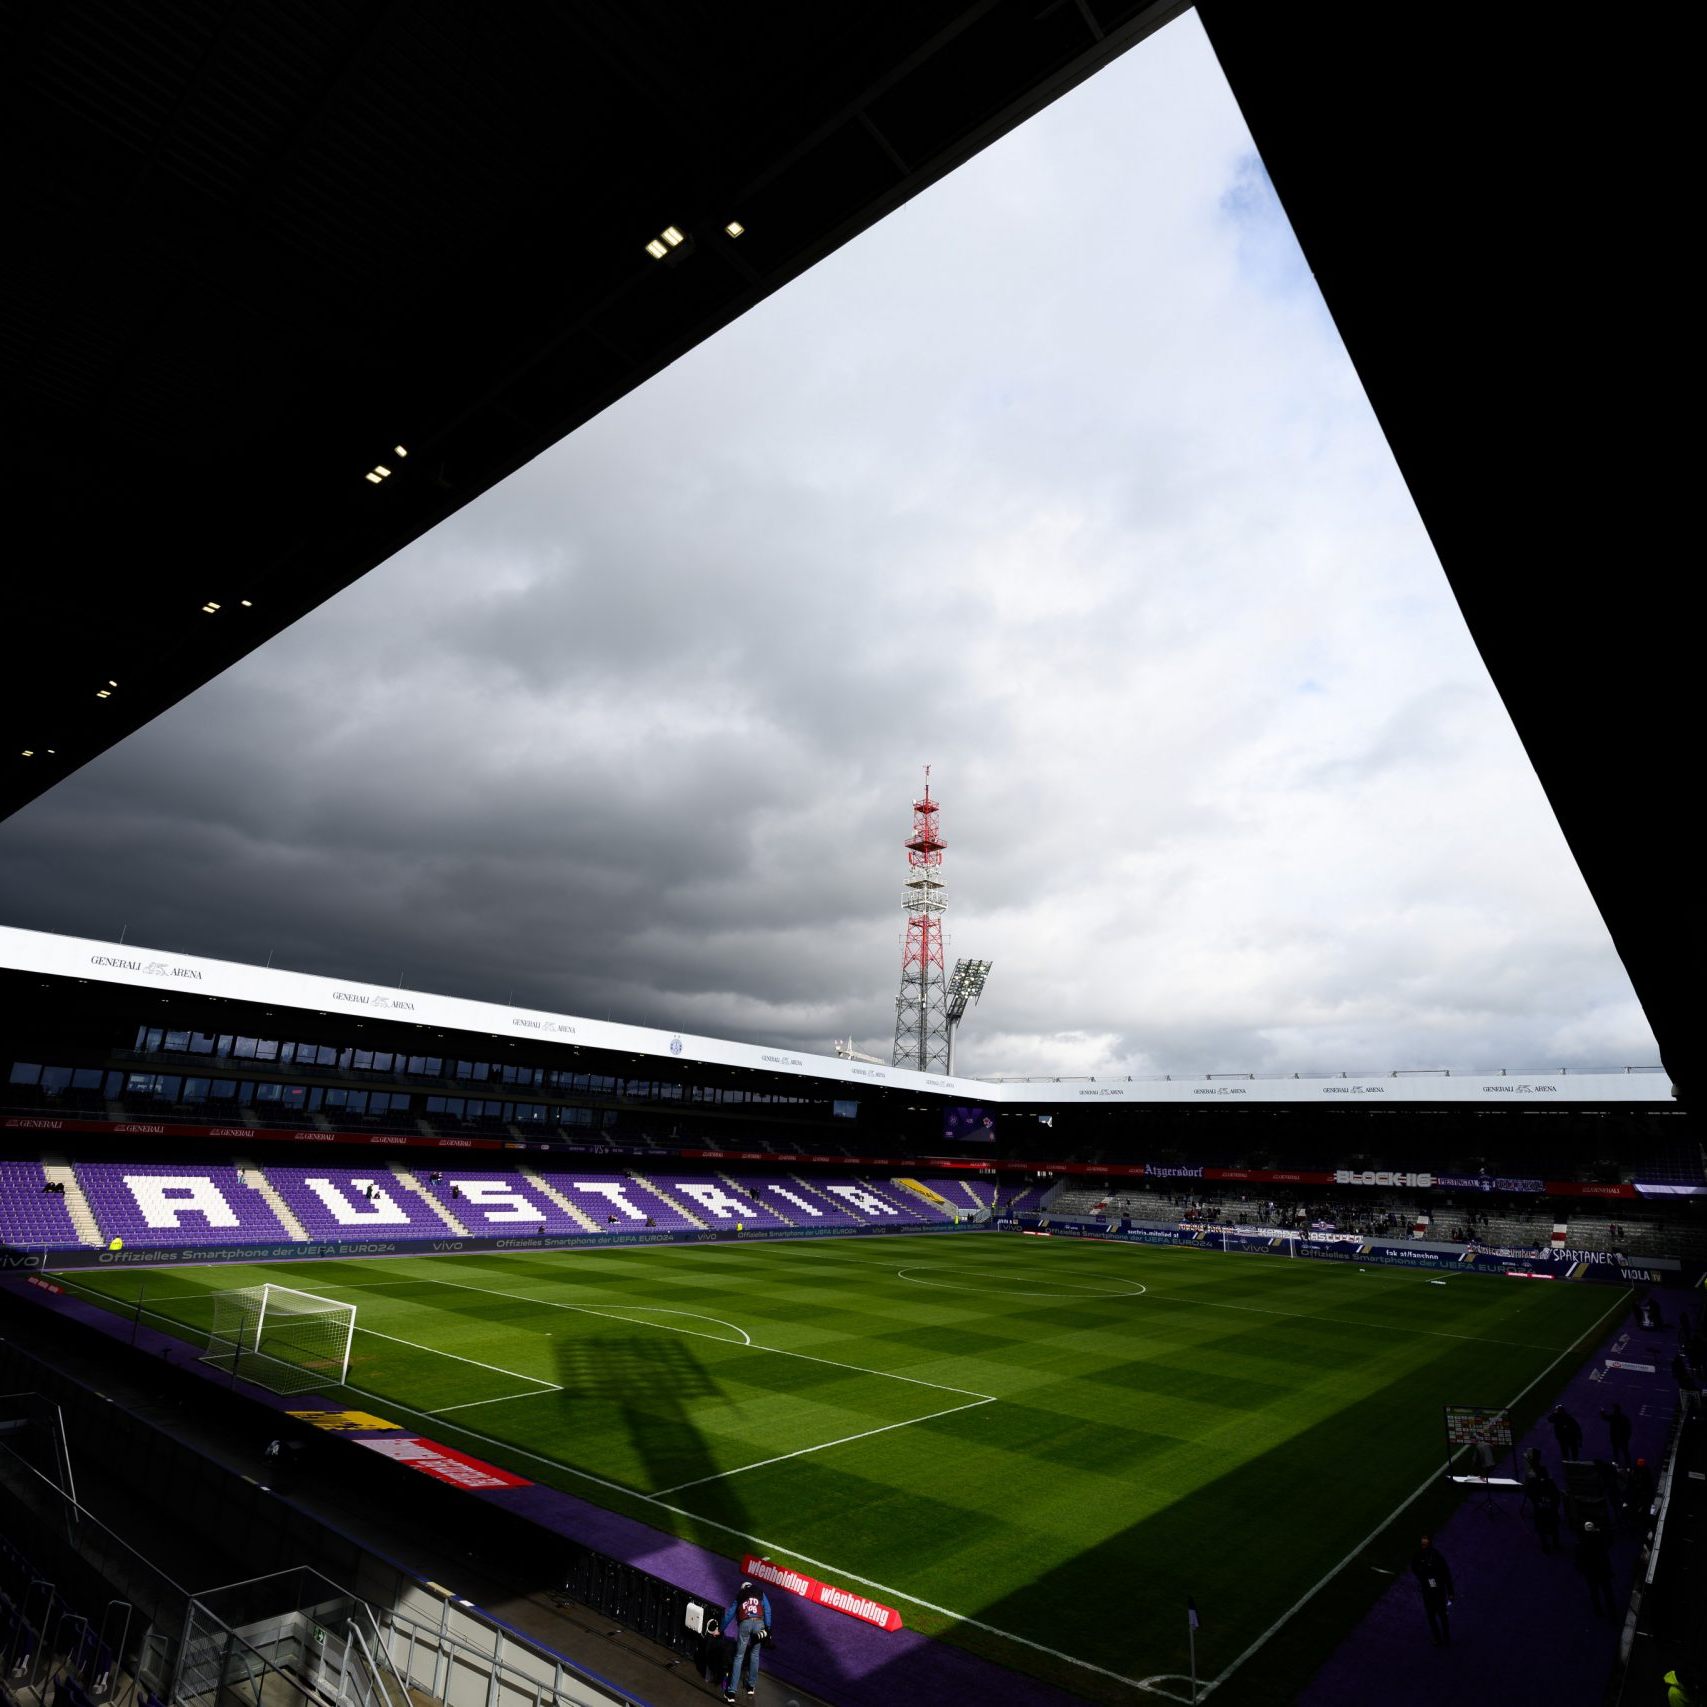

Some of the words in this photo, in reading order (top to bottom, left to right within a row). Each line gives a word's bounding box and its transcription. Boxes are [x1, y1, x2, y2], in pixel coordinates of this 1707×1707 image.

[91, 955, 142, 971] GENERALI
[170, 967, 203, 980] ARENA
[332, 992, 370, 1004] GENERALI
[391, 1000, 415, 1011] ARENA
[19, 1119, 63, 1130] GENERALI
[126, 1124, 164, 1135] GENERALI
[220, 1128, 256, 1139] GENERALI
[304, 1134, 335, 1143] GENERALI
[1144, 1164, 1204, 1178] Atzgersdorf
[496, 1239, 543, 1249] Offizielles
[545, 1237, 597, 1247] Smartphone
[638, 1234, 674, 1242] EURO24
[697, 1233, 717, 1241] vivo
[432, 1240, 463, 1251] vivo
[98, 1251, 177, 1264] Offizielles
[181, 1248, 269, 1261] Smartphone
[272, 1247, 295, 1258] der
[297, 1246, 336, 1256] UEFA
[339, 1243, 396, 1255] EURO24
[0, 1254, 40, 1268] ivo
[1620, 1268, 1651, 1281] VIOLA
